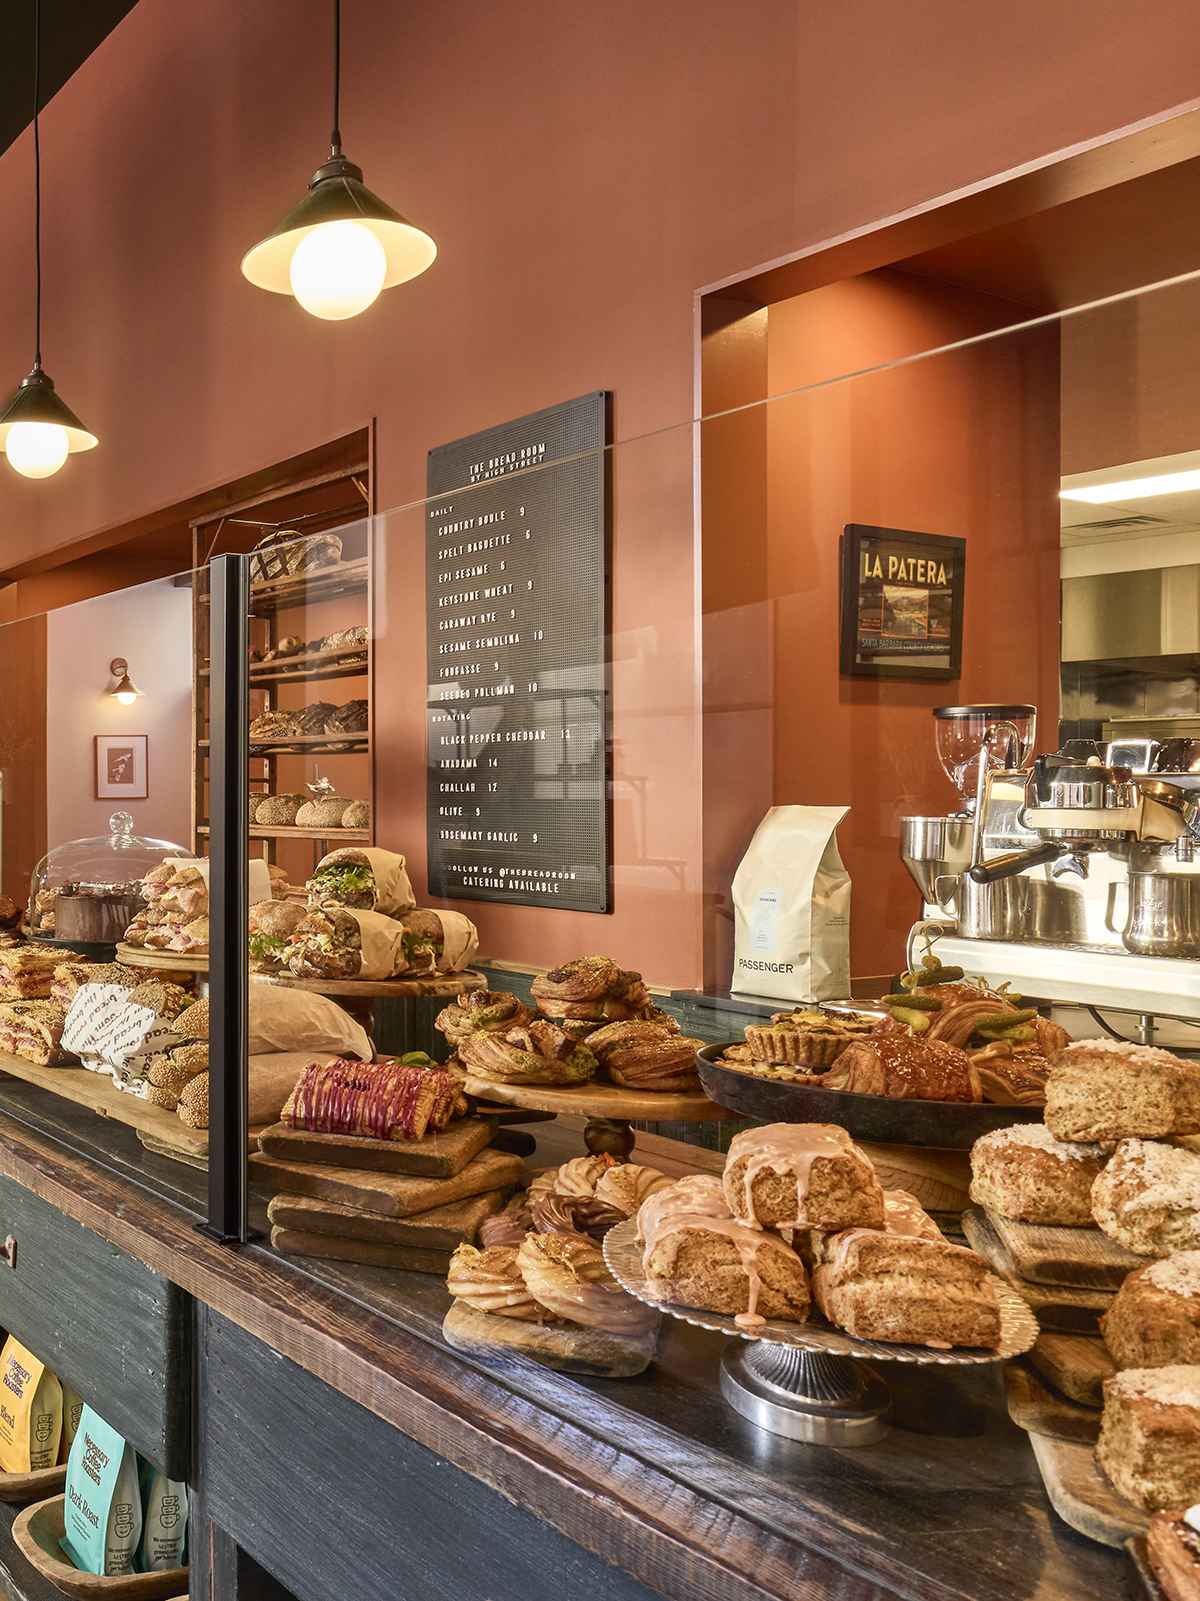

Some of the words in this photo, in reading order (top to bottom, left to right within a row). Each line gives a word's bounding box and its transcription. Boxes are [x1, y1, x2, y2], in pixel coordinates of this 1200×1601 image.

[470, 462, 484, 475] THE
[489, 452, 516, 469] BREAD
[521, 443, 546, 459] ROOM
[485, 469, 505, 479] HIGH
[510, 454, 544, 471] STREET
[430, 506, 453, 518] DAILY
[438, 519, 475, 536] COUNTRY
[478, 510, 506, 526] BOULE
[519, 506, 525, 517] 9
[438, 545, 463, 560] SPELT
[467, 534, 511, 553] BAGUETTE
[439, 572, 452, 583] EPI
[455, 564, 488, 580] SESAME
[500, 560, 506, 570] 6
[864, 553, 883, 579] LA
[888, 556, 947, 585] PATERA
[439, 590, 480, 607] KEYSTONE
[484, 583, 513, 598] WHEAT
[527, 580, 533, 590] 9
[439, 615, 477, 631] CARAWAY
[480, 612, 496, 624] RYE
[510, 609, 516, 619] 9
[439, 640, 471, 654] SESAME
[476, 633, 520, 649] SEMOLINA
[534, 630, 543, 640] 10
[440, 664, 480, 678] FOUGASSE
[494, 661, 499, 671] 9
[439, 689, 470, 701] SEEDED
[528, 682, 538, 693] 10
[440, 735, 466, 745] BLACK
[469, 733, 501, 744] PEPPER
[506, 730, 546, 742] CHEDDAR
[560, 729, 570, 739] 13
[440, 759, 477, 769] ANADAMA
[488, 758, 498, 768] 14
[440, 783, 476, 792] CHALLAH
[488, 782, 497, 792] 12
[439, 806, 463, 816] OLIVE
[475, 807, 481, 817] 9
[487, 831, 519, 842] GARLIC
[532, 833, 538, 843] 9
[499, 868, 576, 880] @THEBREADROOM
[463, 876, 504, 888] CATERING
[508, 879, 560, 893] AVAILABLE
[738, 958, 794, 974] PASSENGER
[69, 1484, 84, 1511] Dark
[82, 1499, 99, 1529] Roast
